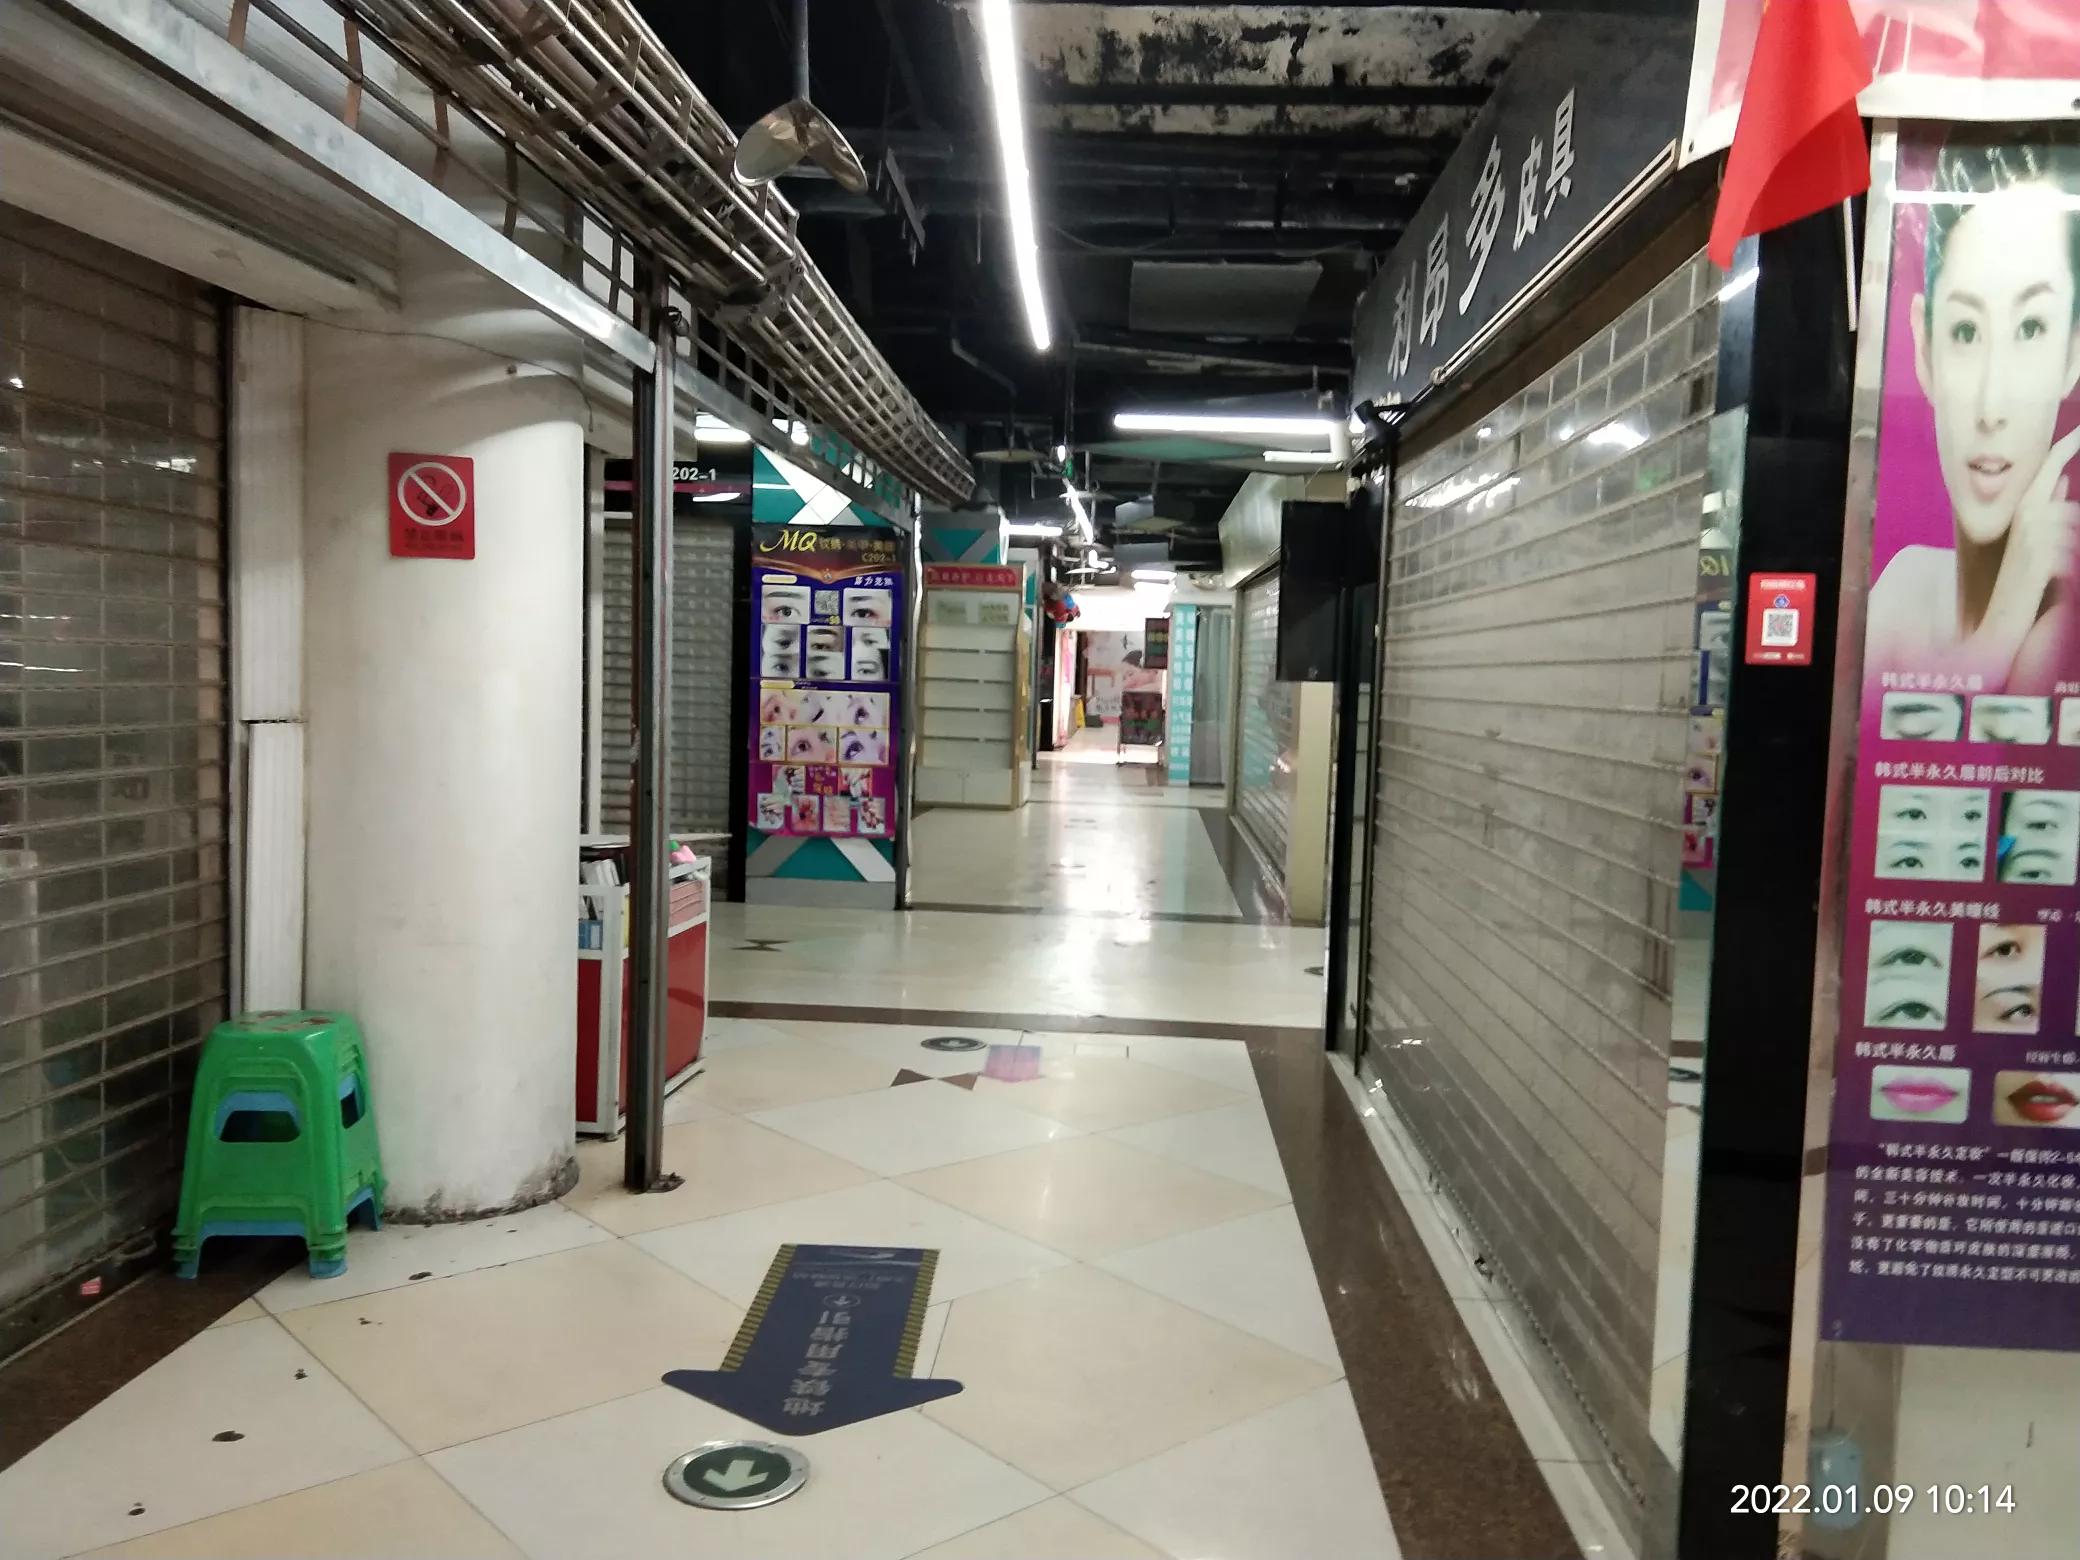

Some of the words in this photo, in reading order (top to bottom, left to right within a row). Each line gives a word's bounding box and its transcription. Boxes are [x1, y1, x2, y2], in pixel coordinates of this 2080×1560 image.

[1387, 87, 1576, 381] 利昂多皮具
[759, 529, 818, 553] MQ
